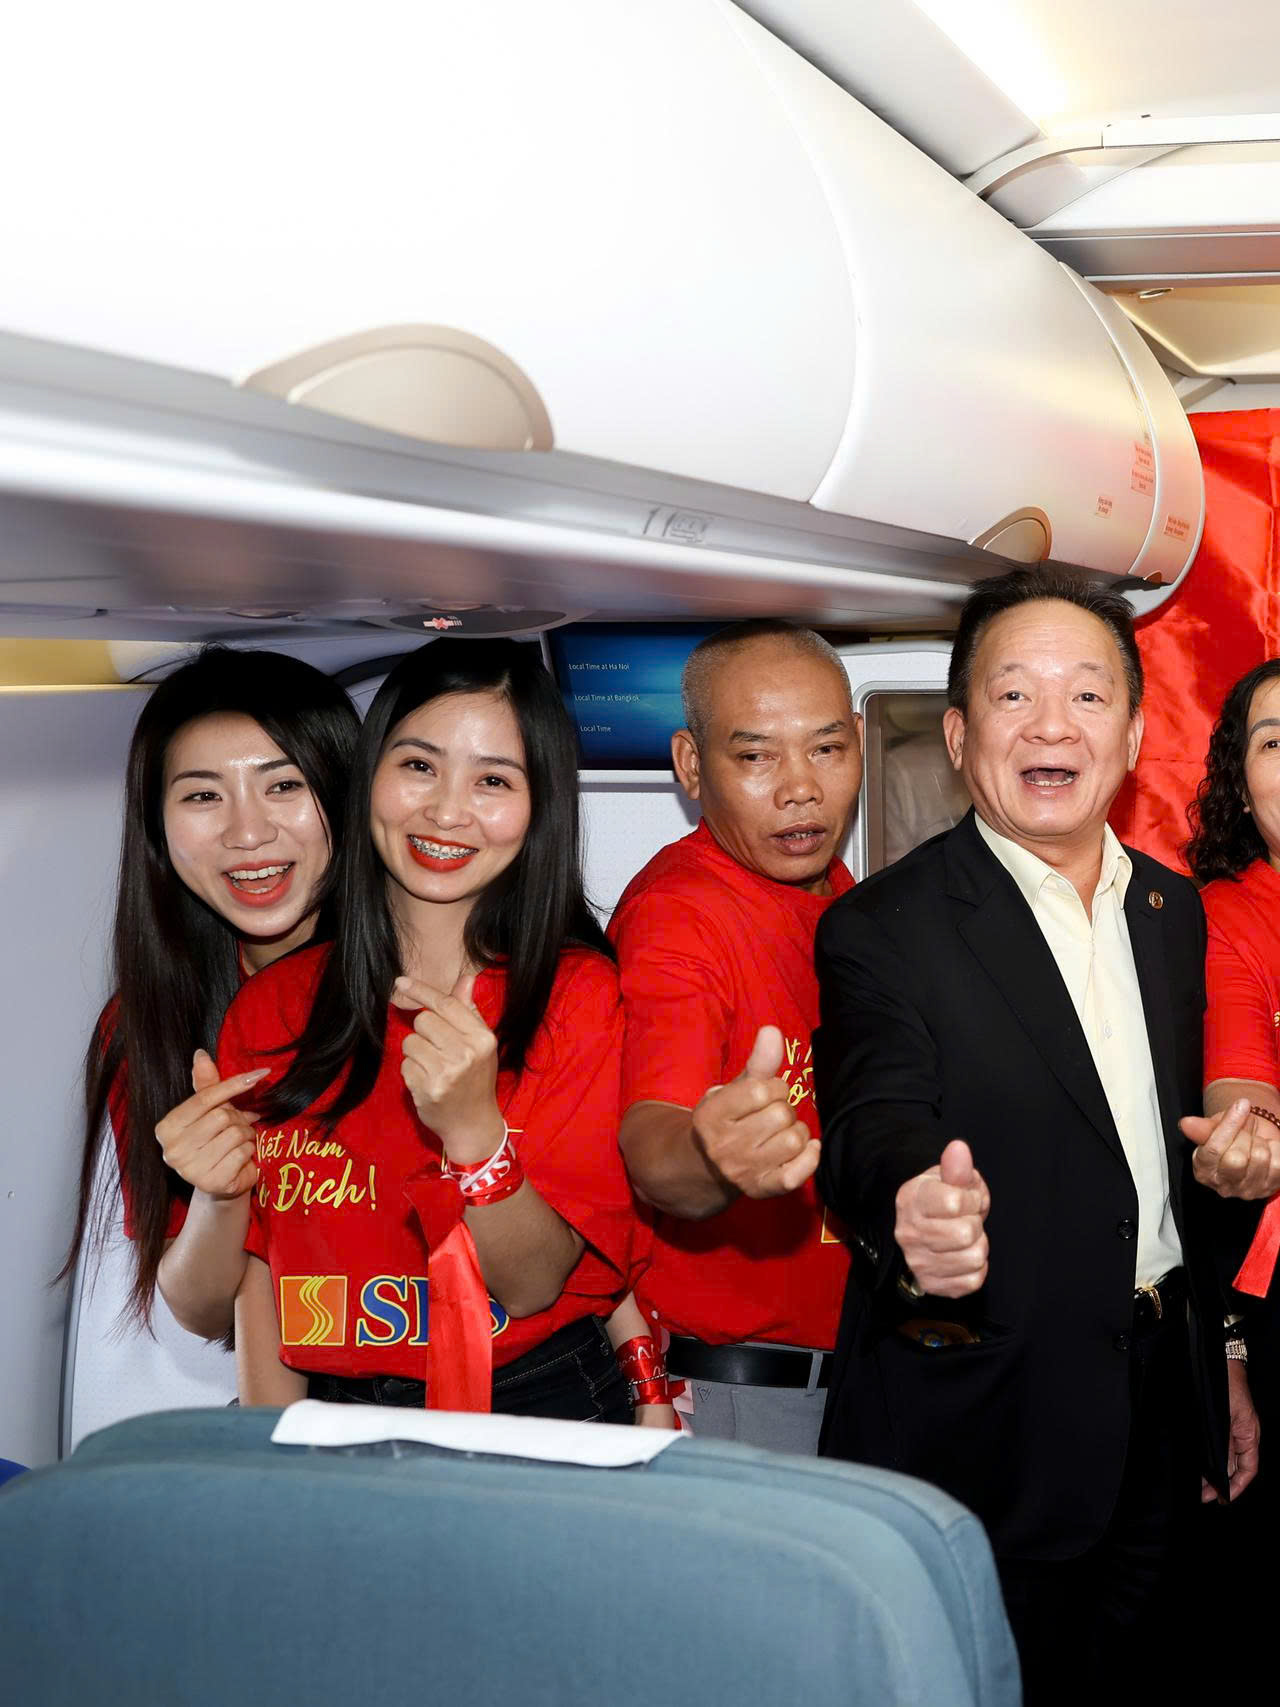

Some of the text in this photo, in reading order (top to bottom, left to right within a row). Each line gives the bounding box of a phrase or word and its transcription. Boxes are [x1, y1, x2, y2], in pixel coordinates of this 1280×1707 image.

[614, 694, 640, 703] Bangkok
[286, 1128, 347, 1159] Nam
[272, 1158, 377, 1216] Địch!
